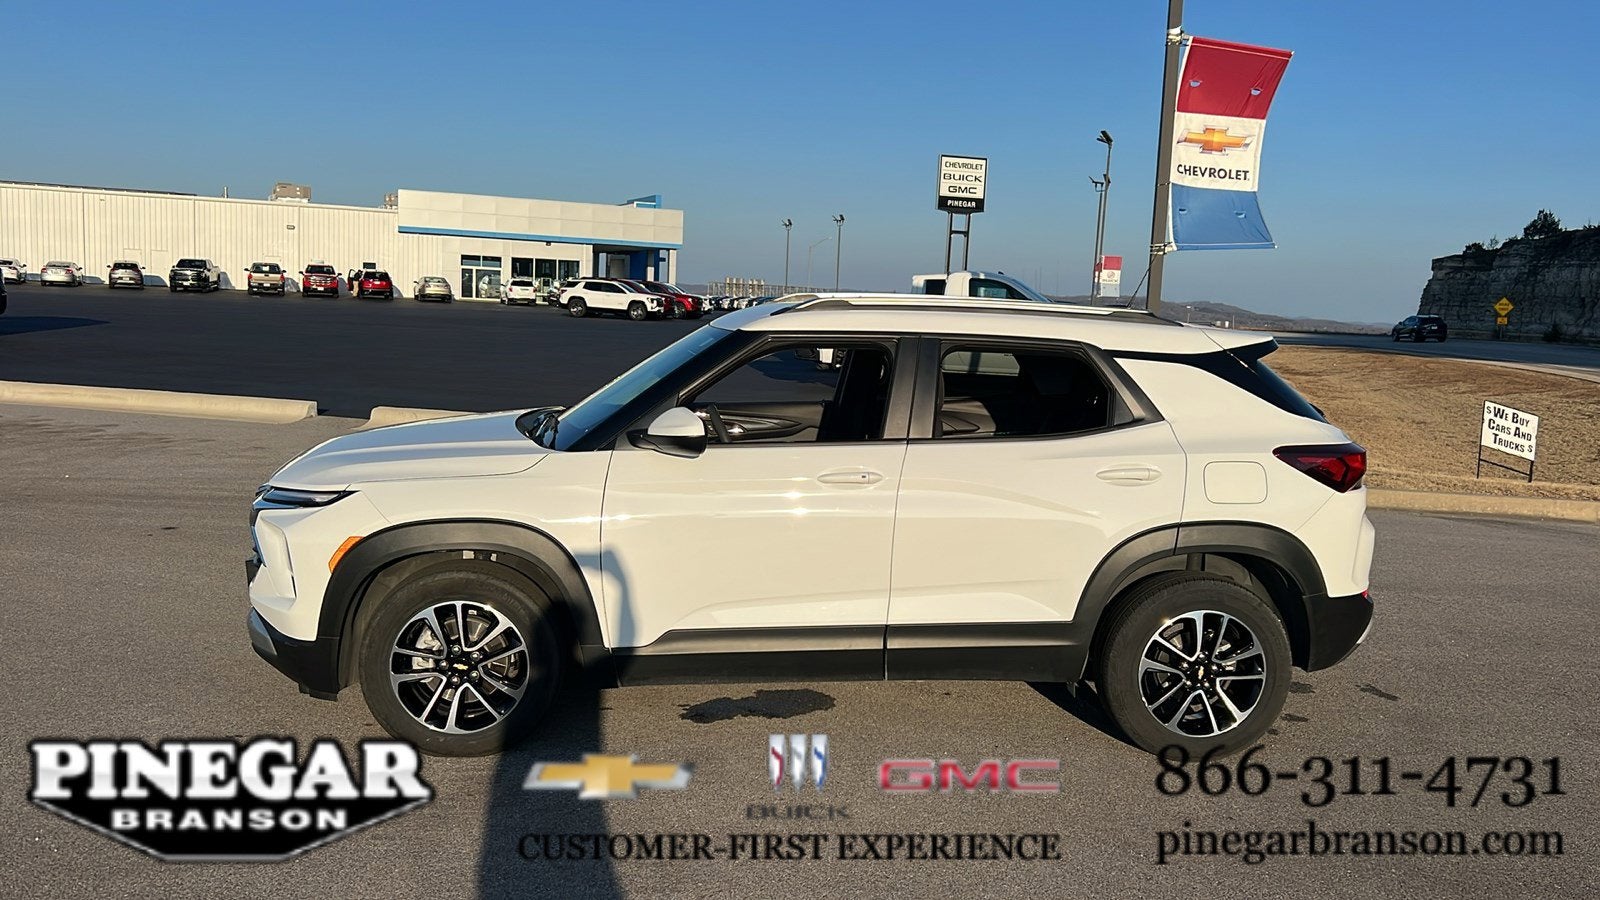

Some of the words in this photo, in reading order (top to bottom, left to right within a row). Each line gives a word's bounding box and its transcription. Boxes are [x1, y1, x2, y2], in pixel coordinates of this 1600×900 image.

[944, 161, 983, 170] CHEVROLET
[1176, 164, 1250, 180] CHEVROLET
[943, 173, 983, 182] BUICK
[948, 186, 977, 194] GMC
[947, 199, 976, 208] PINEGAR
